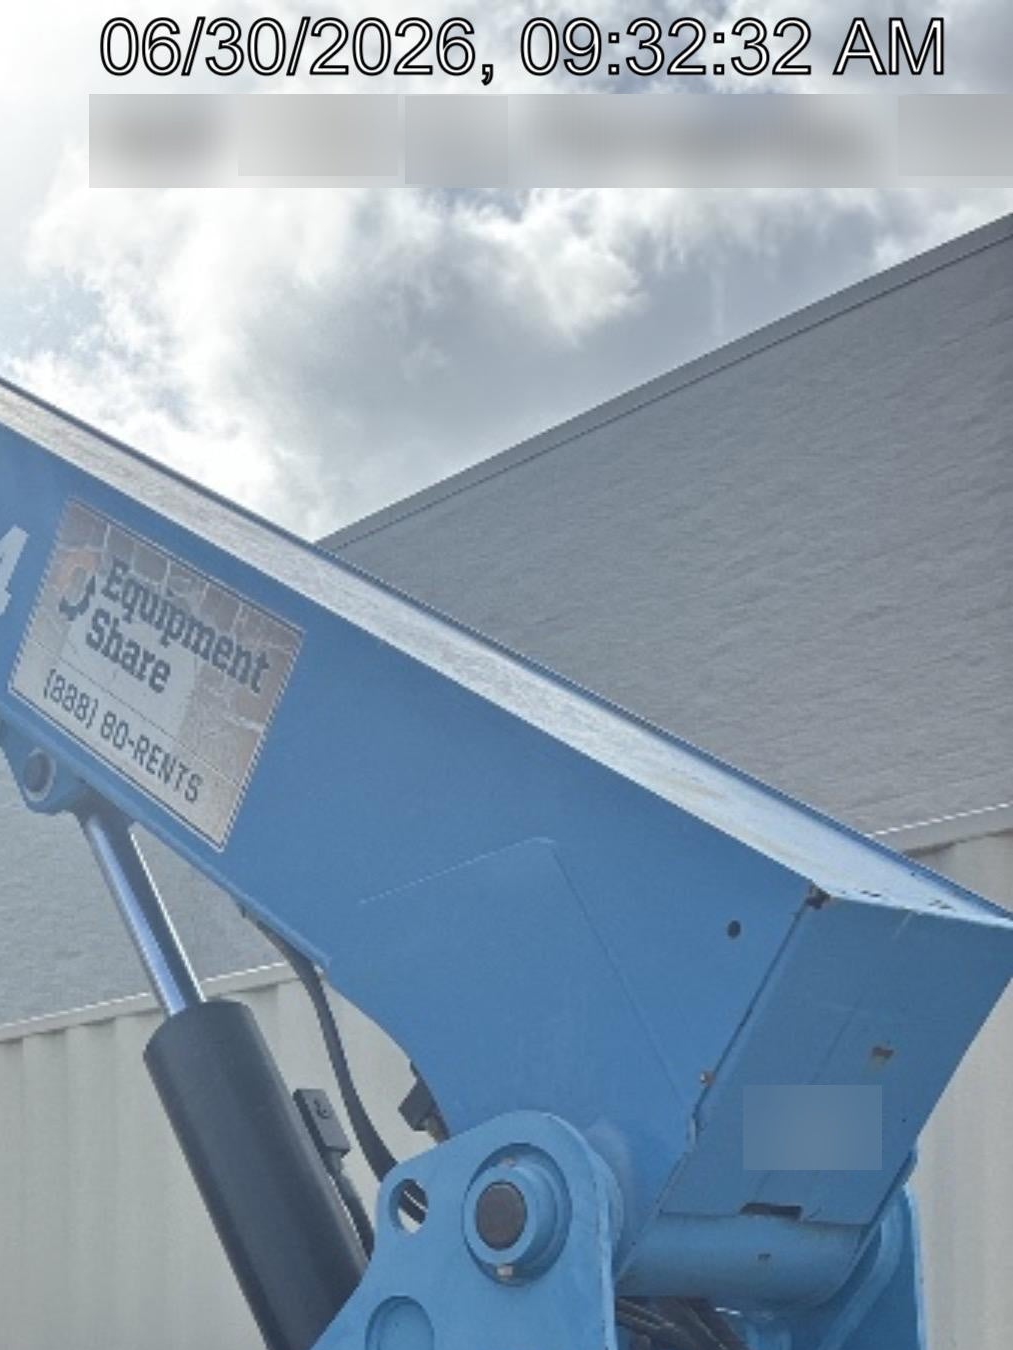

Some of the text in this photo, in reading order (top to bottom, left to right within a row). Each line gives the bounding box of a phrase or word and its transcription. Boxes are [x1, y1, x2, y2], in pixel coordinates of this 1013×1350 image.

[85, 607, 171, 694] Share
[101, 559, 270, 694] Equipment
[43, 668, 205, 803] (888) 80-RENTS
